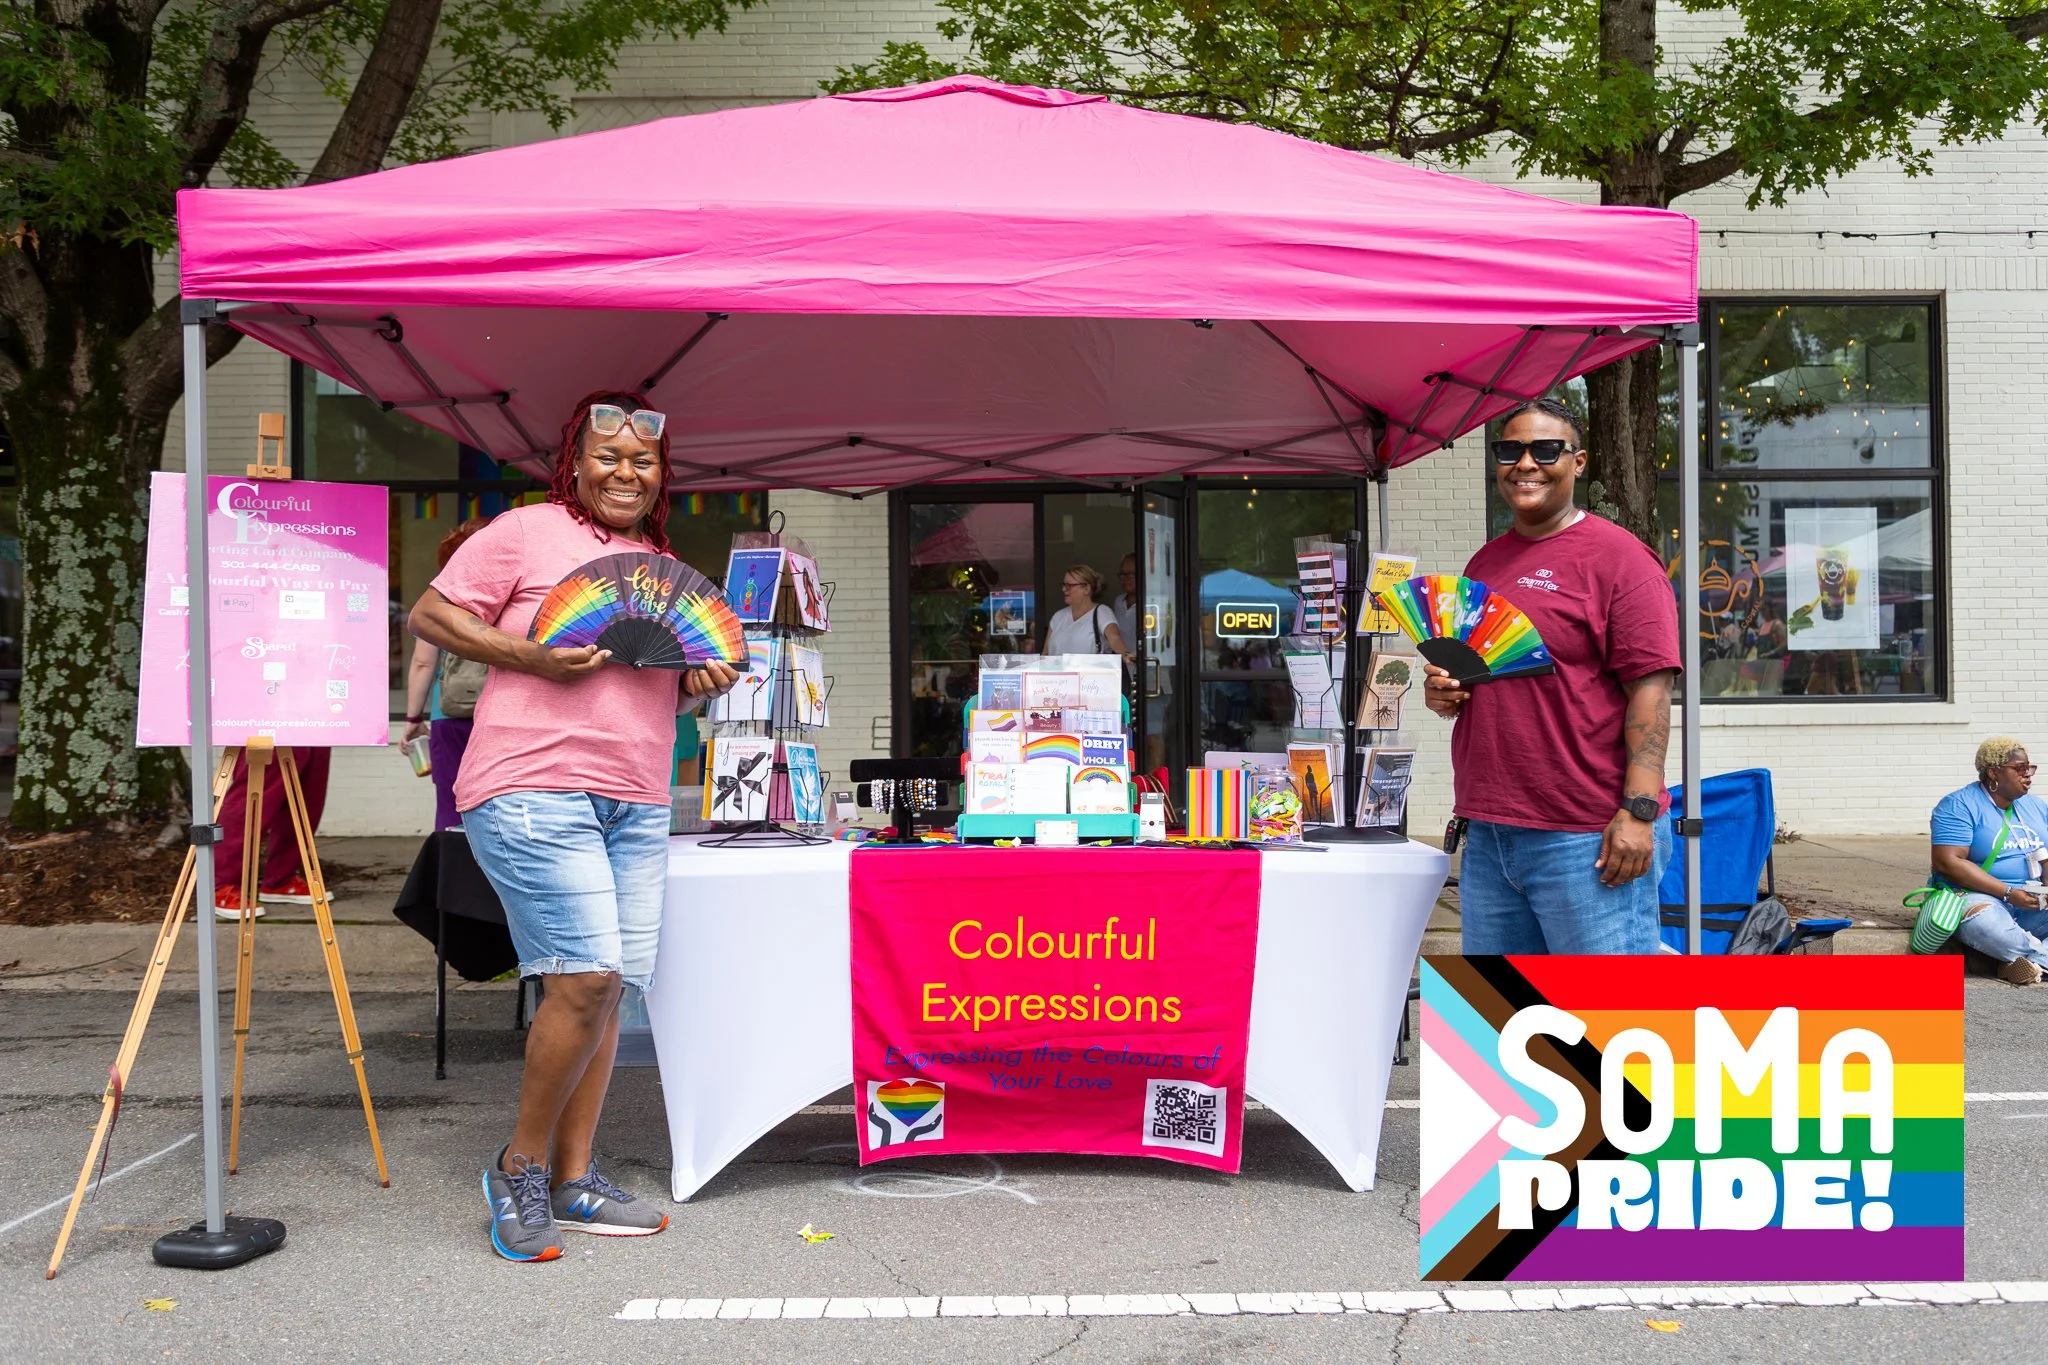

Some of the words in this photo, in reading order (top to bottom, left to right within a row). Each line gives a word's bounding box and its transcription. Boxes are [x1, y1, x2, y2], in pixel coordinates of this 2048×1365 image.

[217, 482, 311, 519] Colourful
[230, 509, 356, 545] Expressions
[253, 546, 287, 557] Card
[291, 547, 355, 560] Company
[220, 560, 320, 572] 501-444-CARD
[1387, 561, 1405, 569] Happy
[182, 572, 266, 588] Clourful
[272, 576, 312, 590] Way
[317, 579, 335, 590] to
[340, 579, 371, 593] Pay
[232, 599, 250, 608] Pay
[643, 589, 656, 601] is
[1223, 612, 1272, 629] OPEN
[949, 915, 1156, 961] Colourful
[922, 983, 1182, 1032] Expressions
[884, 1045, 1023, 1071] Expressing
[1033, 1043, 1072, 1064] the
[1083, 1046, 1183, 1069] Colours
[1193, 1045, 1223, 1070] of
[989, 1072, 1045, 1092] Your
[1054, 1073, 1113, 1091] Love
